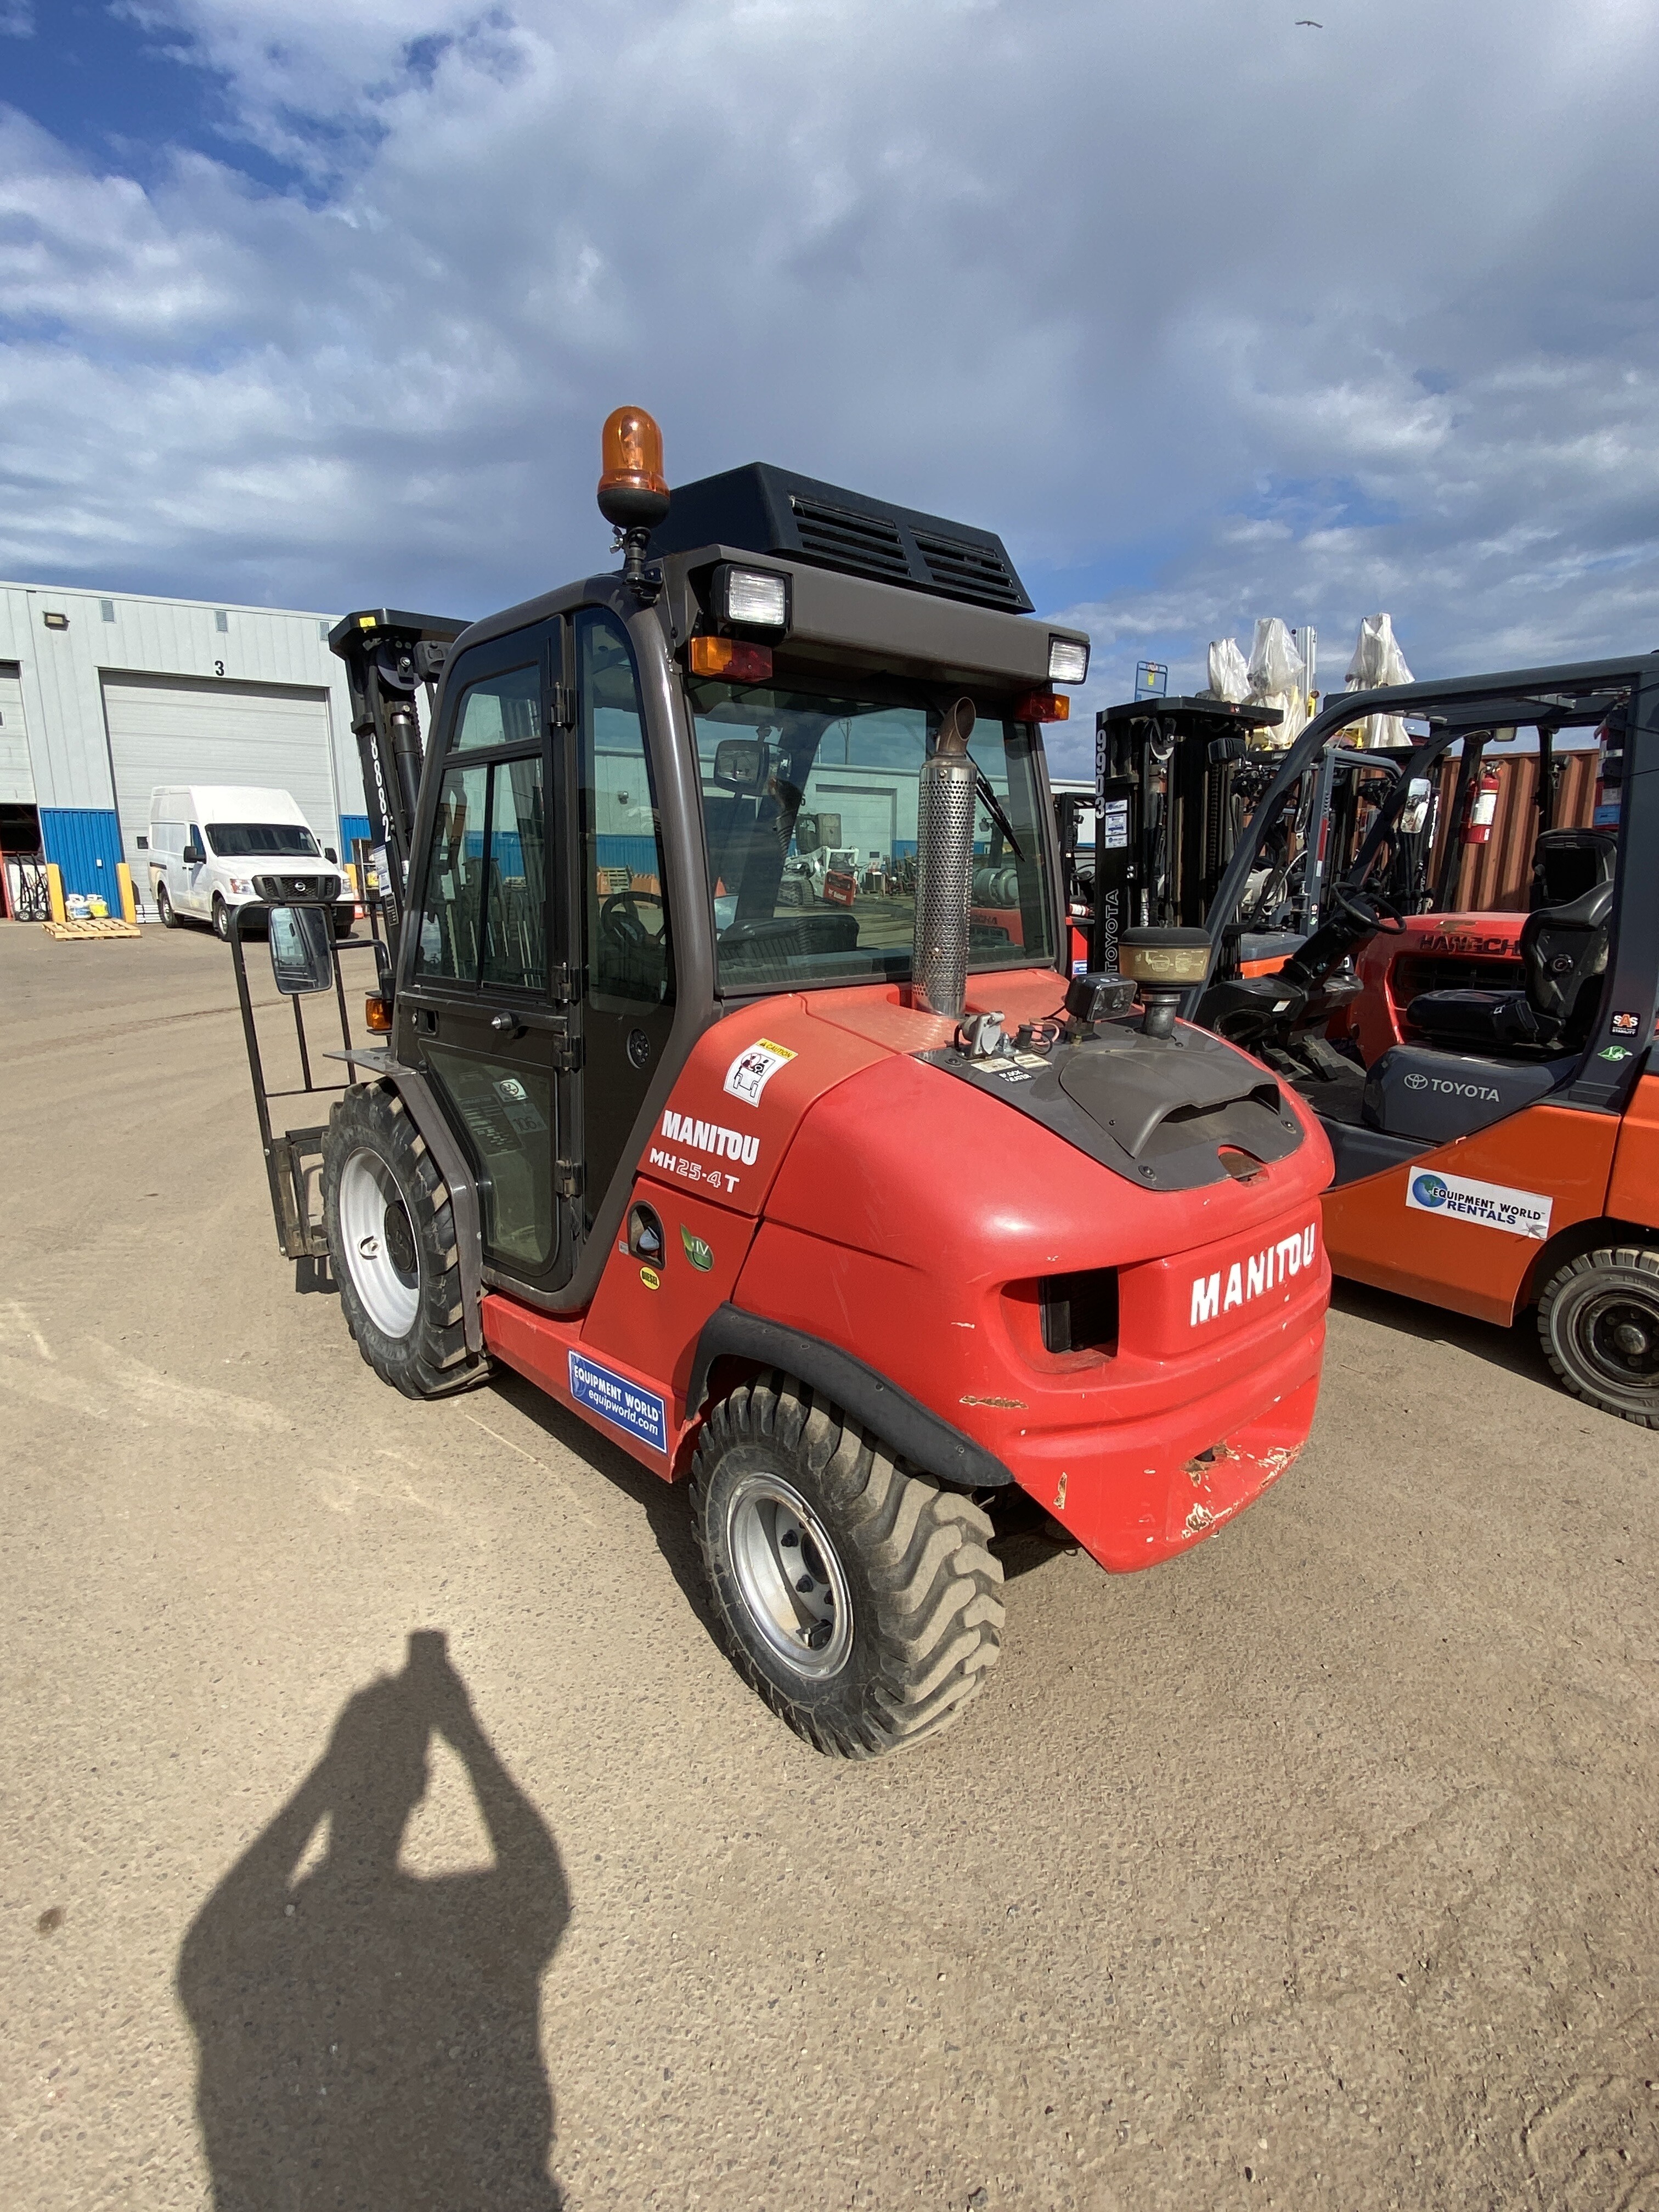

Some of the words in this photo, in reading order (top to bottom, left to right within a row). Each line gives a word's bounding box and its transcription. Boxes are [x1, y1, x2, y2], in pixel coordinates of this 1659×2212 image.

[215, 660, 224, 676] 3
[370, 732, 391, 842] 8882
[1095, 729, 1107, 819] 9903
[1104, 888, 1119, 972] TOYOTA
[1613, 1014, 1638, 1028] SAS
[766, 1043, 793, 1058] CAUTION
[1431, 1079, 1500, 1102] TOYOTA
[661, 1109, 760, 1166] MANITOU
[1433, 1187, 1495, 1209] EQUIPMENT
[1447, 1200, 1516, 1224] RENTALS
[641, 1270, 658, 1286] DIESEL
[1190, 1222, 1316, 1327] MANITOU
[574, 1365, 622, 1402] EQUIPMENT
[589, 1389, 658, 1436] equipworld.com
